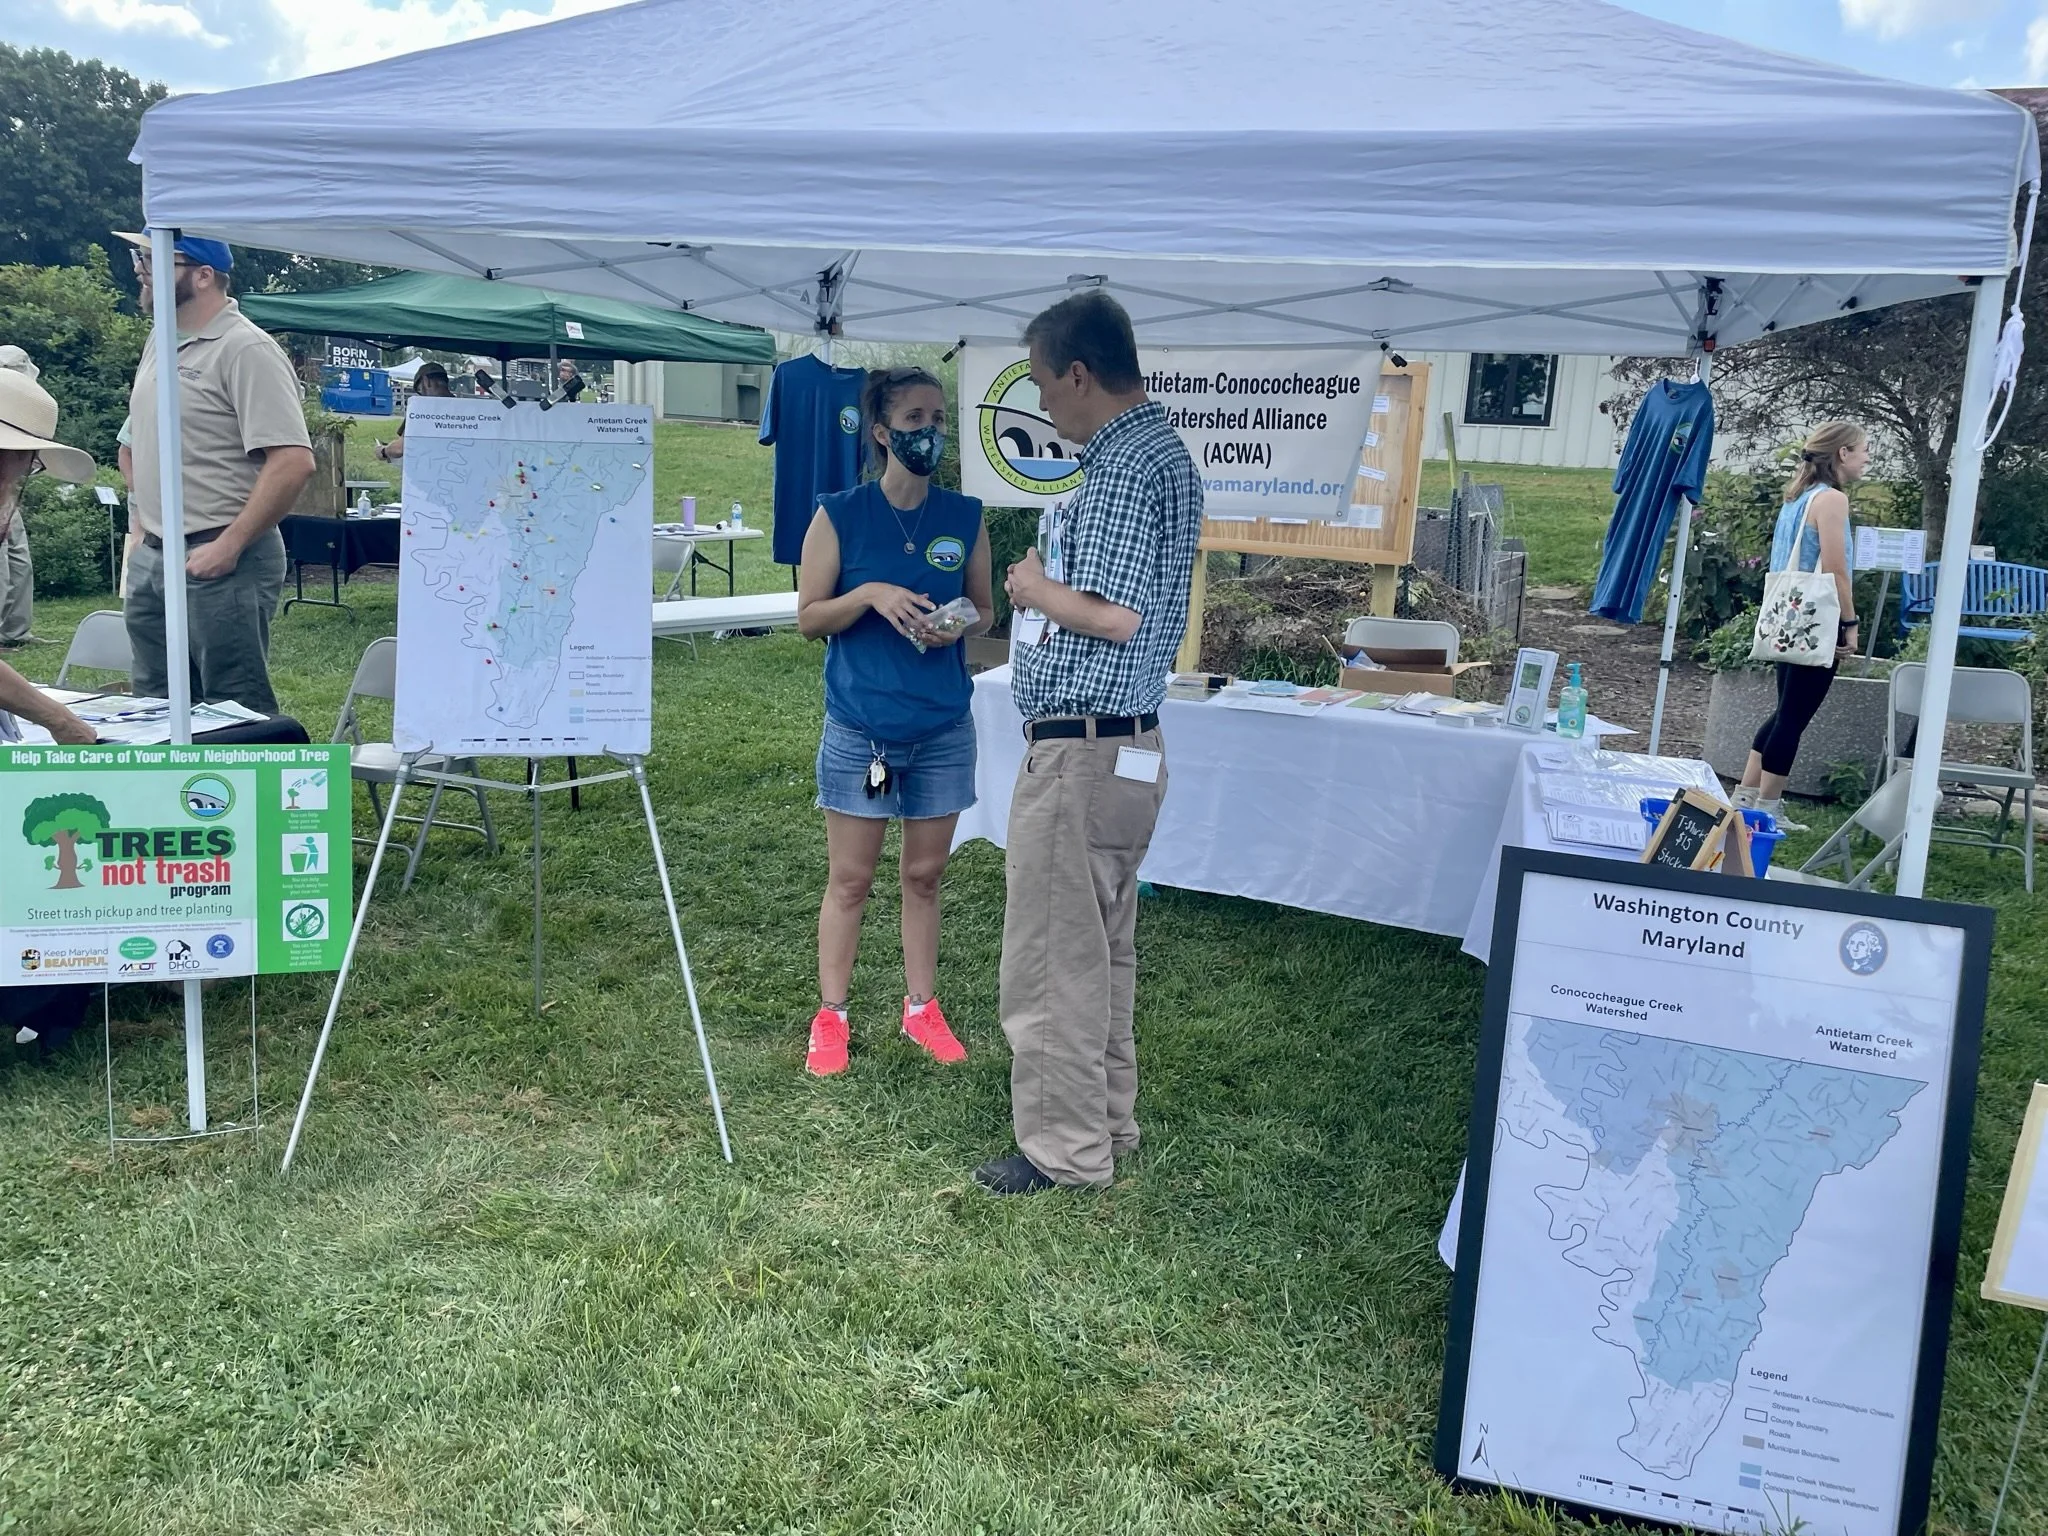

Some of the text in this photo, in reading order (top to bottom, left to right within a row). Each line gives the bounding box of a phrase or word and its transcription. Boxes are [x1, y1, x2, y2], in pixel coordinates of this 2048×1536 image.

[333, 346, 368, 359] BORN
[333, 356, 376, 369] READY.
[992, 362, 1031, 397] ANTIETA
[1142, 371, 1360, 399] ntietam-Conococheague
[409, 412, 475, 422] Conococheague
[1165, 407, 1328, 431] atershed Alliance
[435, 422, 478, 430] Watershed
[983, 424, 1084, 491] WATERSHED ALLIANC
[1203, 442, 1272, 469] (ACWA)
[1201, 477, 1345, 499] wamaryland.or
[569, 644, 594, 652] Legend
[11, 749, 330, 766] Help Take Care of Your New Neighborhood Tree
[96, 830, 232, 857] TREES
[1675, 832, 1692, 850] $15
[1657, 847, 1691, 869] Stick
[102, 854, 231, 886] not trash
[170, 885, 231, 899] program
[27, 903, 232, 920] Street trash pickup and tree planting
[1593, 892, 1804, 940] Washington County
[44, 947, 108, 957] Keep Maryland
[1641, 928, 1745, 959] Maryland
[44, 957, 108, 968] BEAUTIFUL
[169, 960, 200, 970] DHCD
[1550, 984, 1684, 1013] Conococheague Creek
[1585, 1003, 1648, 1021] Watershed
[1815, 1025, 1914, 1049] Antietam Creek
[1829, 1040, 1897, 1060] Watershed
[1750, 1367, 1788, 1382] Legend
[1772, 1402, 1800, 1414] Streams
[1773, 1389, 1803, 1401] Antietam
[1812, 1396, 1868, 1414] Conococheague
[1479, 1422, 1489, 1435] N
[1770, 1415, 1829, 1434] County Boundary
[1769, 1429, 1791, 1439] Roads
[1767, 1442, 1800, 1456] Municipal
[1765, 1469, 1795, 1481] Antietam
[1796, 1475, 1817, 1485] Creek
[1820, 1494, 1840, 1505] Creek
[1740, 1516, 1749, 1524] 10
[1746, 1507, 1765, 1519] Miles
